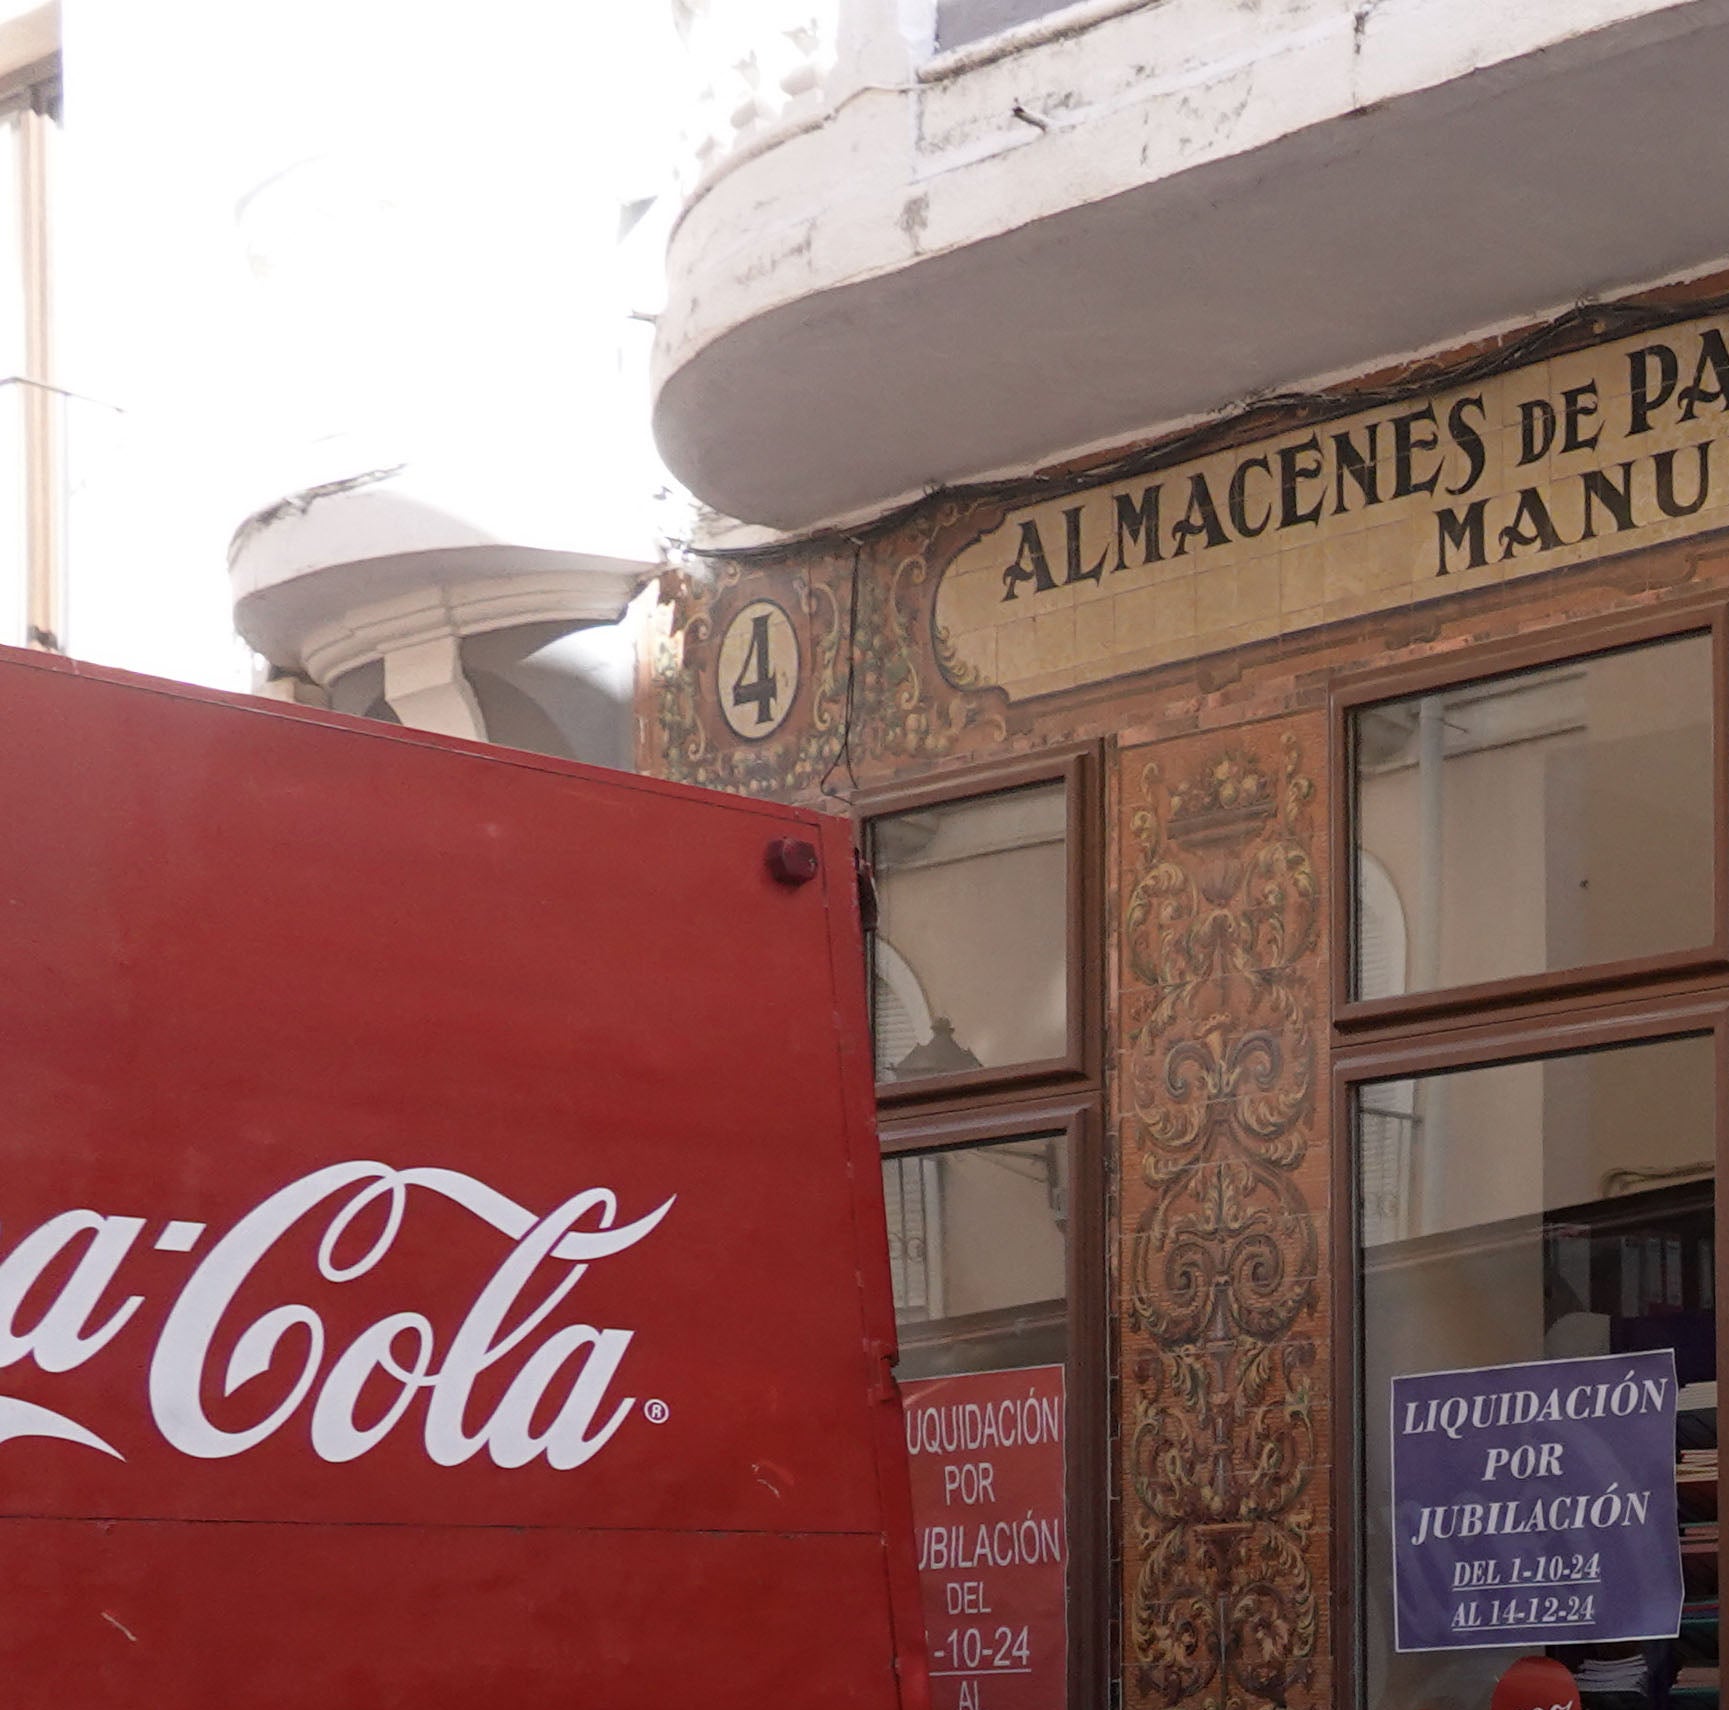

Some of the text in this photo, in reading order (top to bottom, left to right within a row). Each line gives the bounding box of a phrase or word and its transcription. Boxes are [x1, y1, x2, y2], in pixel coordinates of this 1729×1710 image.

[1003, 391, 1487, 602] ALMACENES
[1515, 379, 1606, 468] DE
[730, 612, 781, 725] 4
[1402, 1369, 1669, 1440] LIQUIDACIÓN
[944, 1462, 996, 1506] POR
[1480, 1442, 1564, 1482] POR
[1411, 1482, 1651, 1546] JUBILACIÓN
[1453, 1552, 1602, 1587] DEL 1-10-24
[946, 1581, 992, 1615] DEL
[1451, 1595, 1596, 1628] AL 14-12-24
